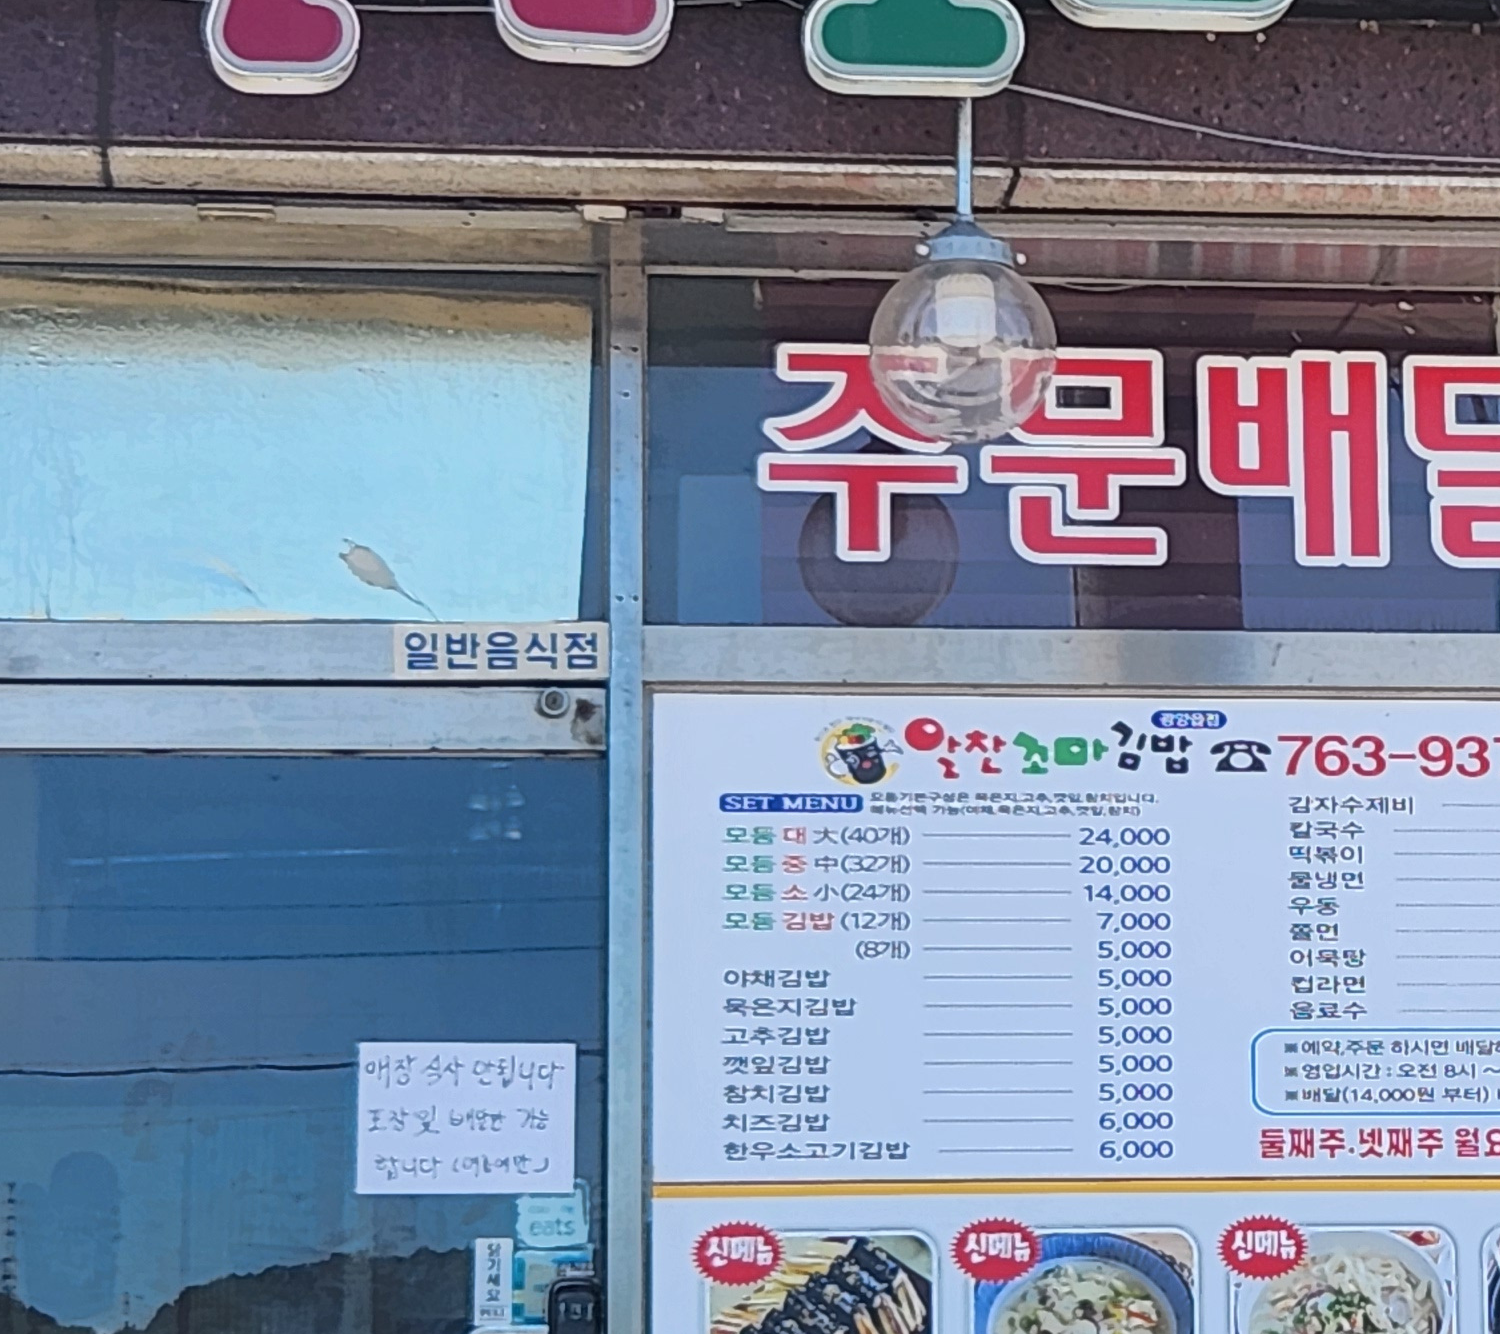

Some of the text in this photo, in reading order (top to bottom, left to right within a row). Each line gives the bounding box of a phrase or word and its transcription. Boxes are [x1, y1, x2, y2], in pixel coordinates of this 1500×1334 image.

[403, 630, 600, 671] 일반음식점
[724, 795, 859, 811] SET MENU
[1288, 795, 1414, 815] 감자수제비
[782, 825, 807, 846] 대
[1078, 826, 1171, 848] 24,000
[1289, 820, 1365, 840] 칼국수
[781, 854, 808, 874] 중
[1078, 855, 1172, 877] 20,000
[1288, 845, 1363, 865] 떡볶이
[1287, 870, 1365, 890] 물냉면
[781, 883, 809, 903] 소
[1083, 884, 1172, 905] 14,000
[1287, 896, 1340, 916] 우동
[782, 911, 836, 932] 김밥
[1098, 912, 1172, 933] 7,000
[1289, 923, 1339, 942] 쫄면
[1097, 940, 1172, 961] 5,000
[1289, 949, 1366, 969] 어묵탕
[723, 969, 1173, 990] 야채김밥 5,000
[1290, 975, 1367, 995] 컵라면
[722, 997, 1173, 1018] 묵은지김밥 5,000
[1289, 1000, 1368, 1021] 음료수
[721, 1026, 1174, 1047] 고추김밥 5,000
[1390, 1039, 1449, 1056] 하시면
[722, 1054, 1174, 1076] 깻잎김밥 5,000
[1396, 1063, 1438, 1080] 오전
[1443, 1063, 1476, 1080] 8시
[722, 1083, 1174, 1104] 참치김밥 5,000
[722, 1112, 1174, 1133] 치즈김밥 6,000
[723, 1140, 1175, 1162] 한우소고기김밥 6,000
[529, 1218, 576, 1237] eats
[704, 1235, 774, 1267] 신메뉴
[962, 1233, 1032, 1264] 신메뉴
[1231, 1229, 1297, 1260] 신메뉴
